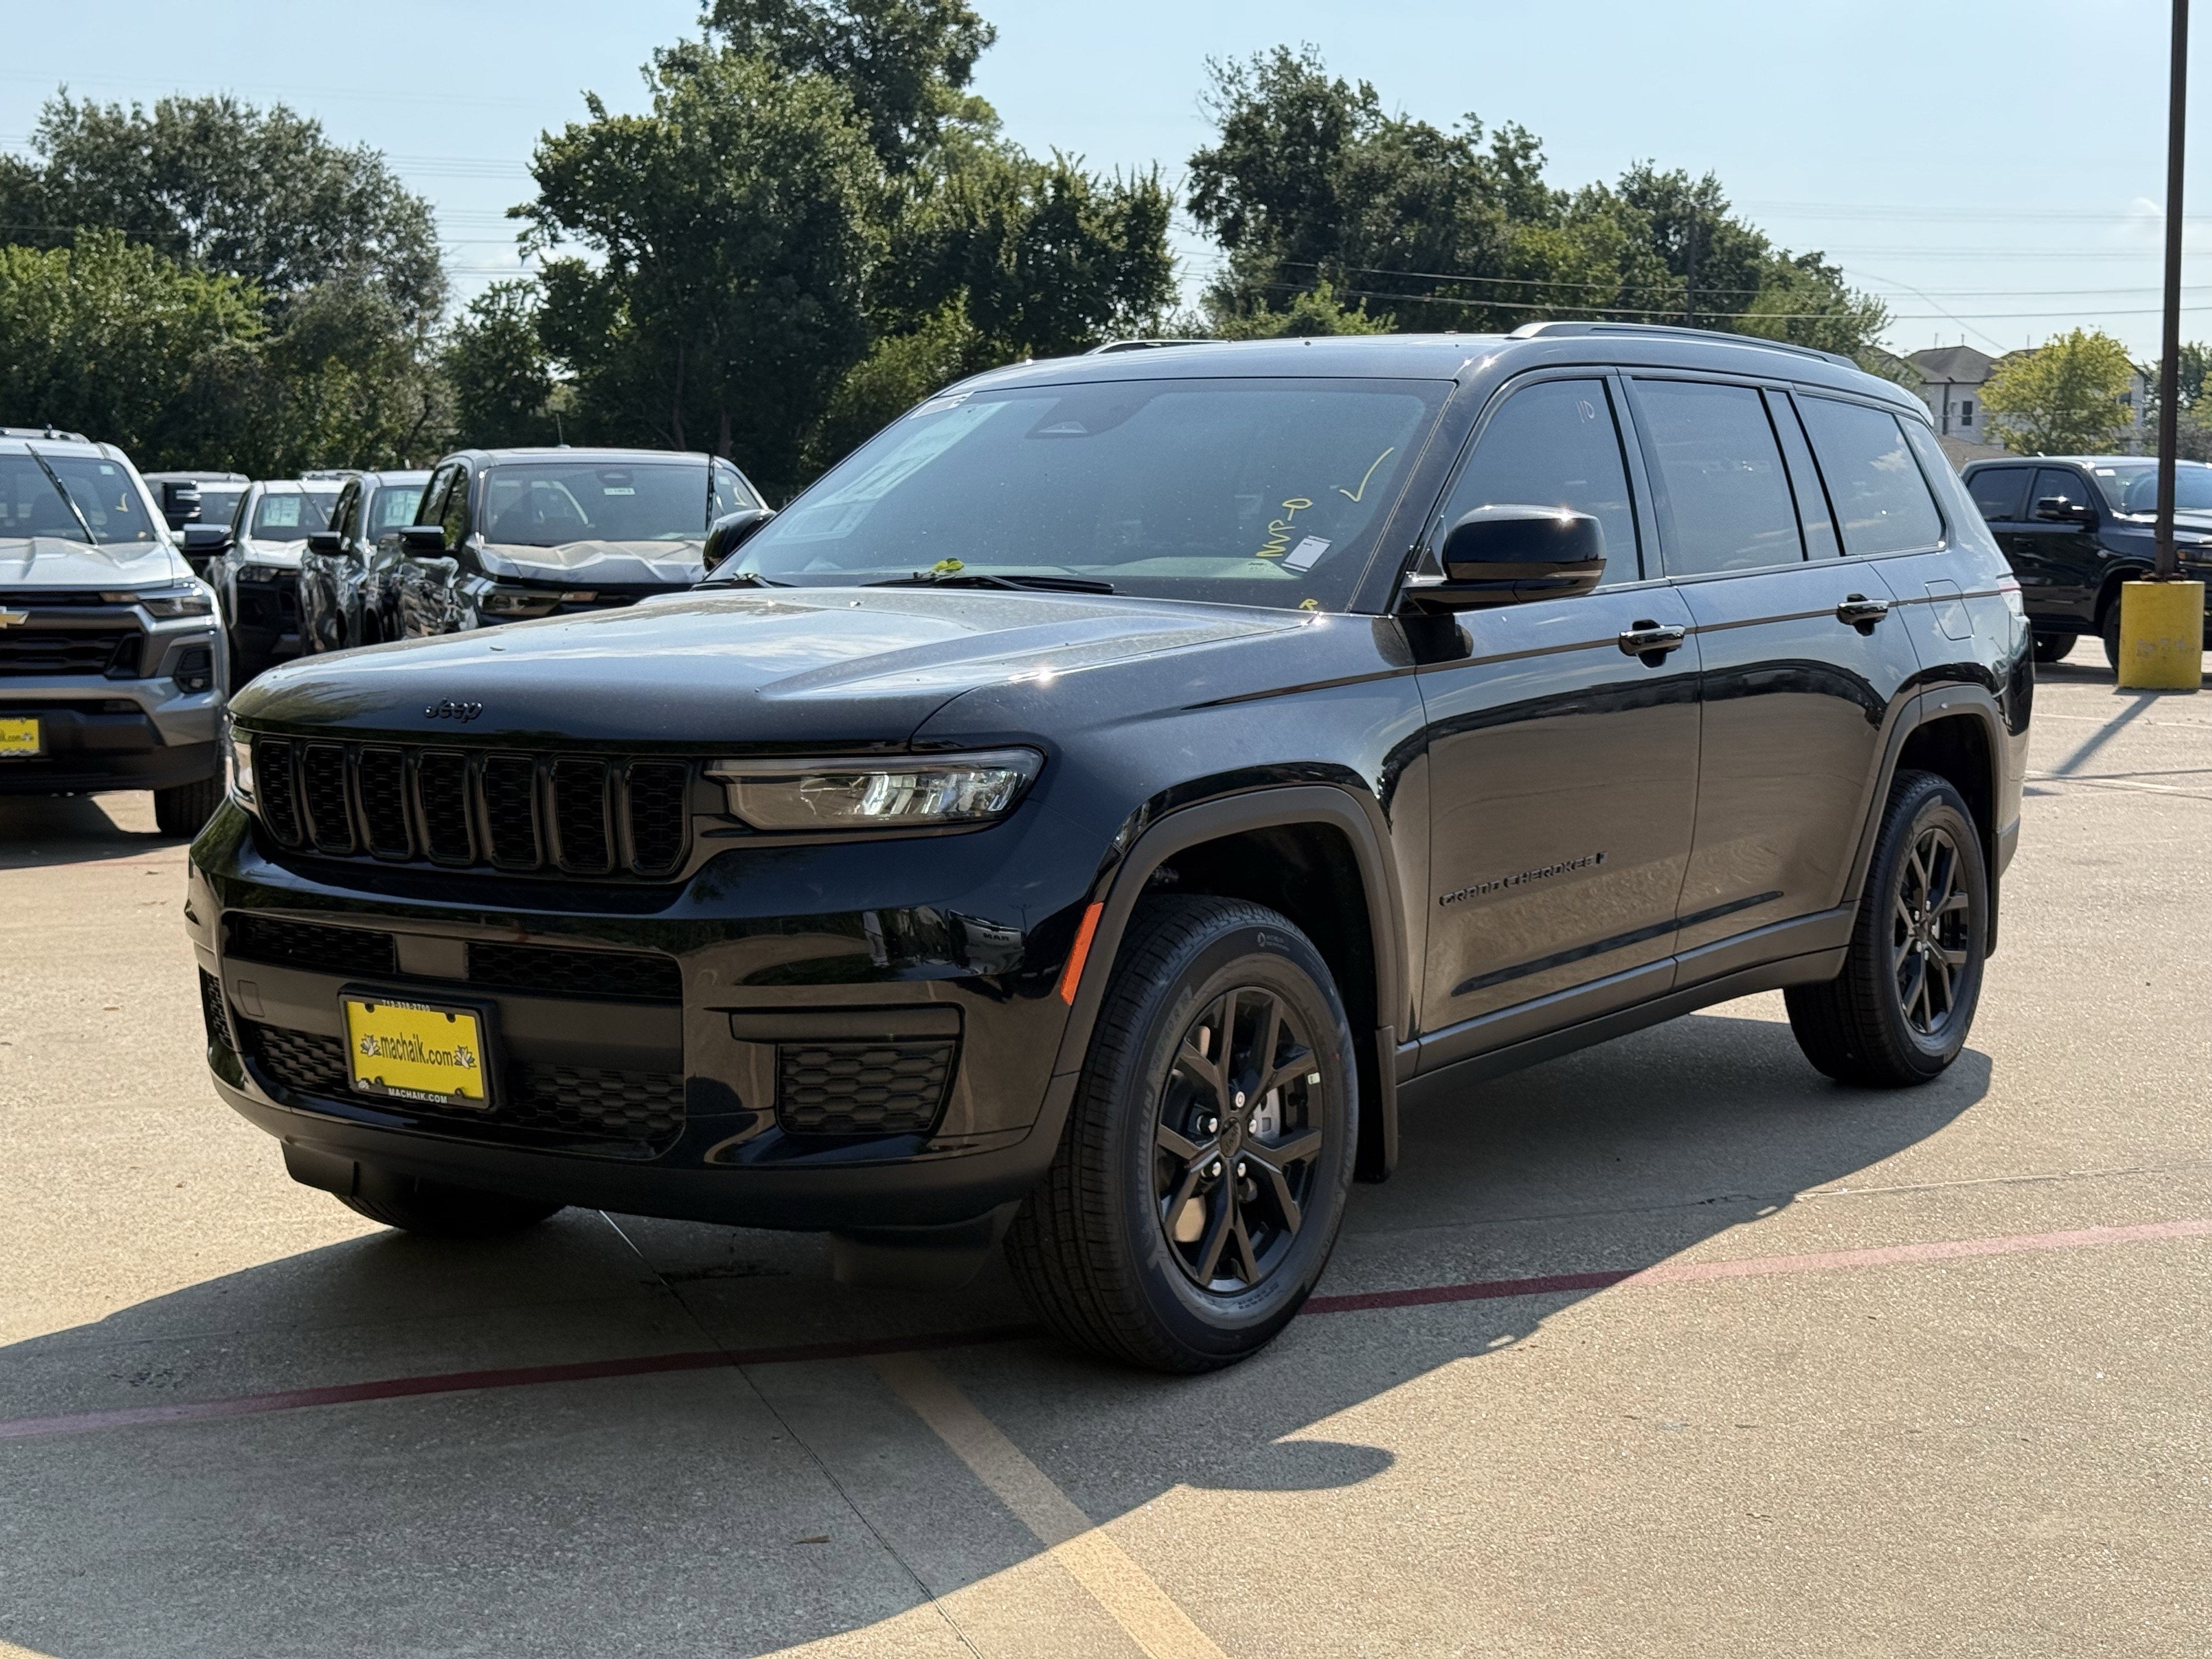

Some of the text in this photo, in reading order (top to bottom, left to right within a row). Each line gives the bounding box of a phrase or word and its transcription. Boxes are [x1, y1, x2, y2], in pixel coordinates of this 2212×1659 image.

[424, 698, 483, 723] Jeep
[1439, 880, 1501, 906] GRAND
[1503, 855, 1594, 888] CHEROKEE
[379, 1031, 454, 1066] machaik.com
[388, 1087, 448, 1104] MACHAIK.COM
[1137, 1090, 1155, 1215] MICHELIN
